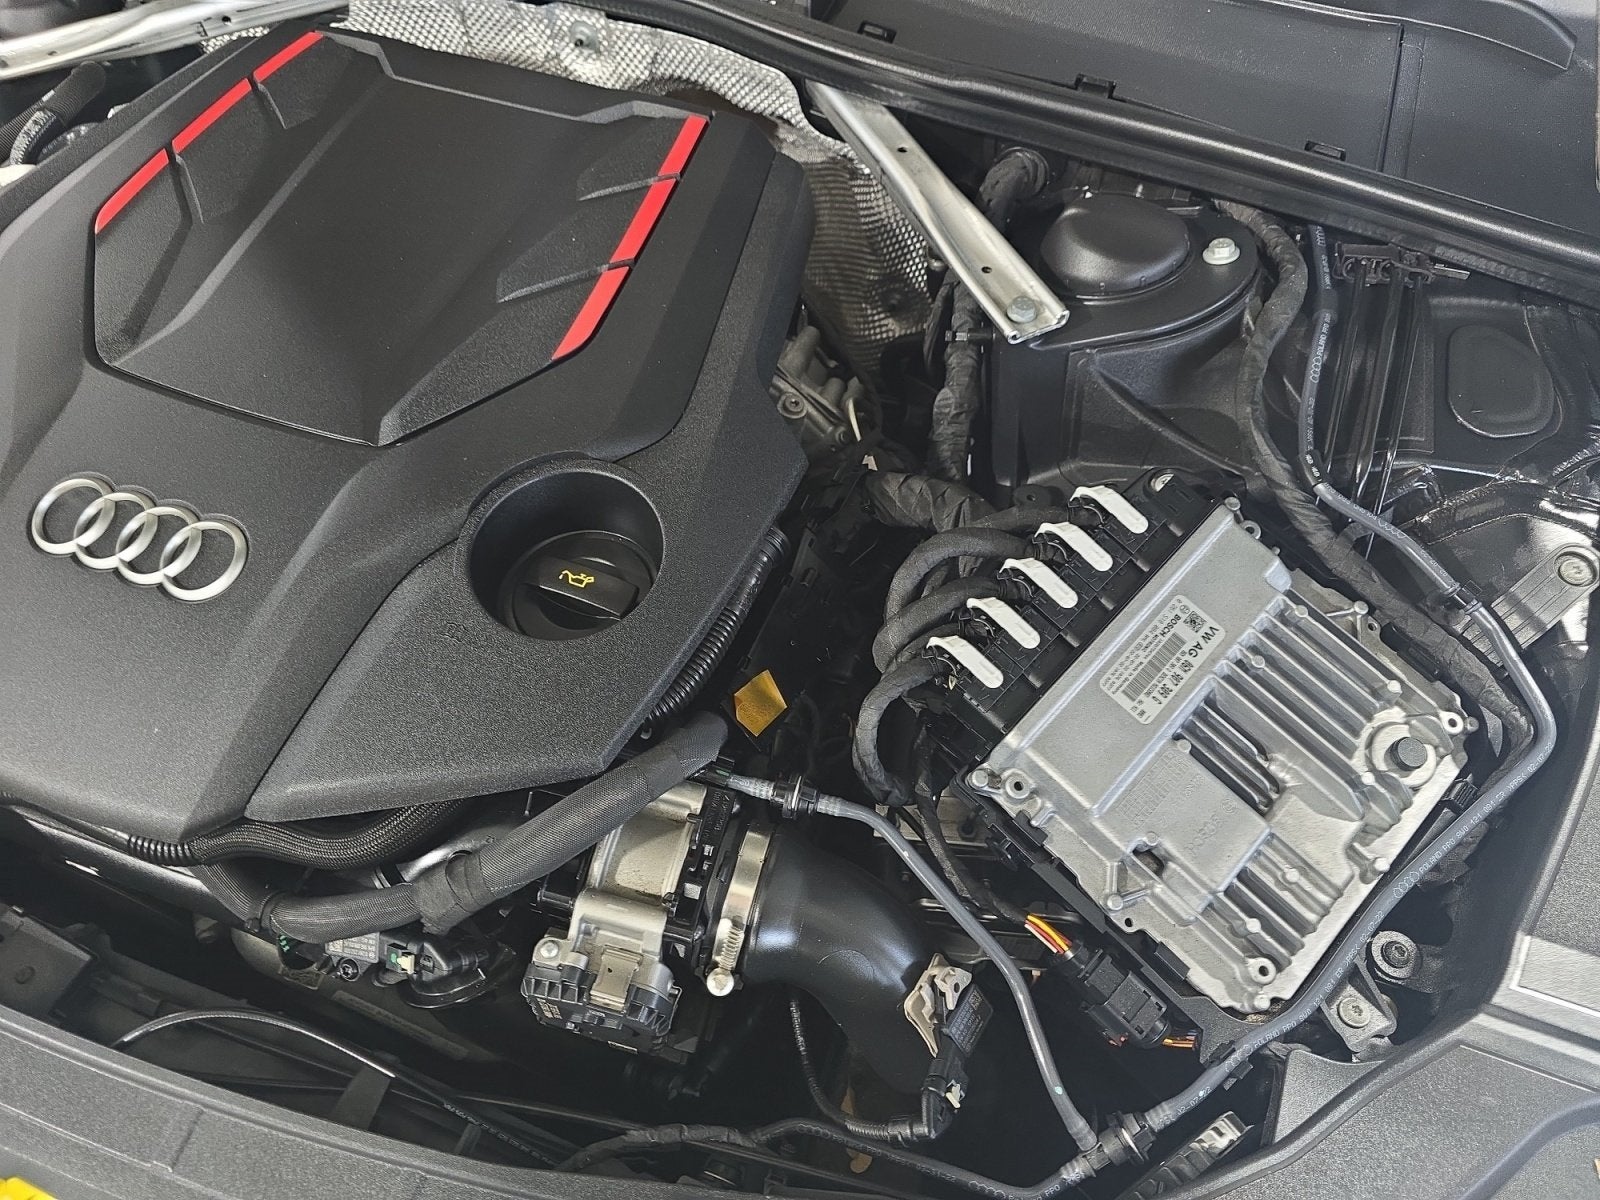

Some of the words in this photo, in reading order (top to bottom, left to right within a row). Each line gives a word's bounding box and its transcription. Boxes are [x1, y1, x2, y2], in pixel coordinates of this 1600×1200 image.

[1159, 613, 1181, 638] BOSCH
[1199, 625, 1219, 643] VW
[1187, 640, 1203, 658] AG
[1168, 671, 1183, 686] 907
[1418, 850, 1443, 874] POLAND
[1254, 1029, 1281, 1049] POLAND
[1335, 967, 1345, 978] ER
[1359, 910, 1385, 942] 02-07-22
